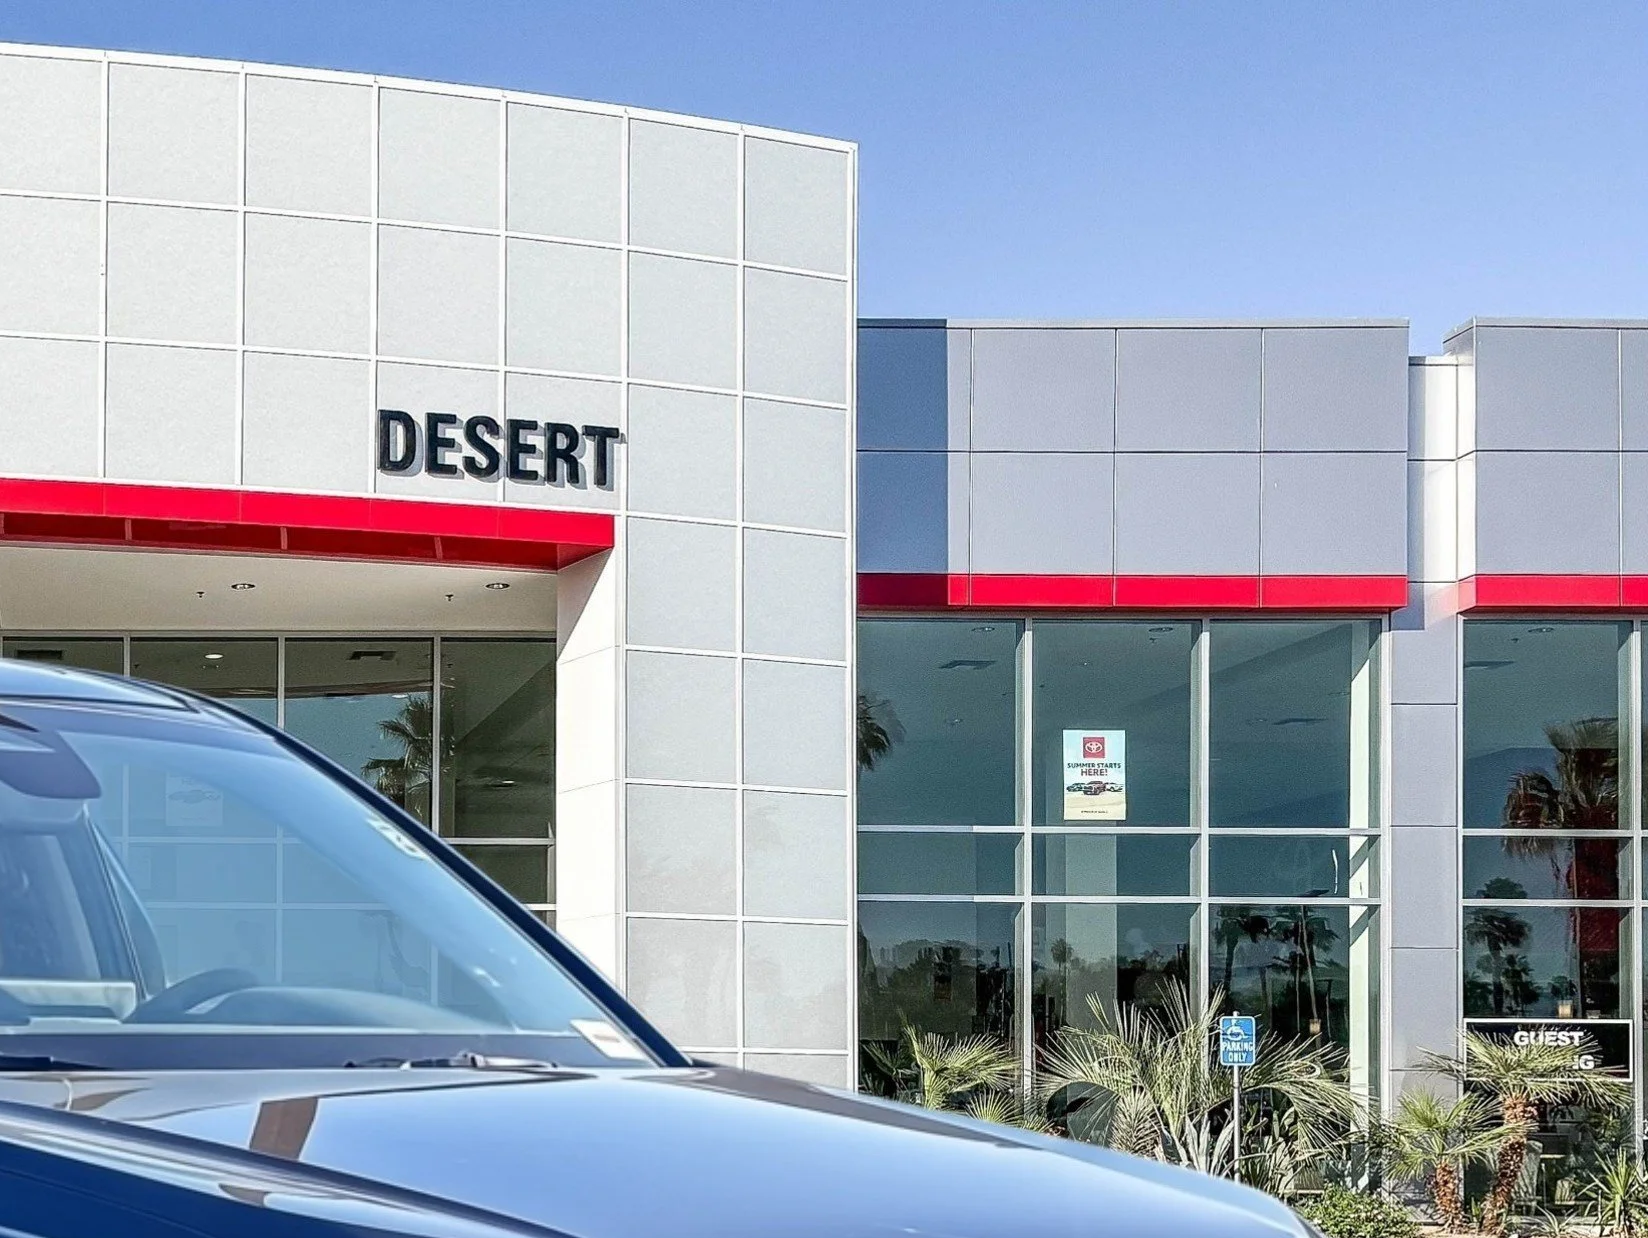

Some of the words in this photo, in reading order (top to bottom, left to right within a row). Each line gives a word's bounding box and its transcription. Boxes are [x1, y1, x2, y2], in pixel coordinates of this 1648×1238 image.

[376, 409, 620, 487] DESERT
[1080, 768, 1108, 776] HERE!
[1513, 1030, 1584, 1047] GUEST
[1222, 1041, 1254, 1052] PARKING
[1228, 1052, 1248, 1062] ONLY
